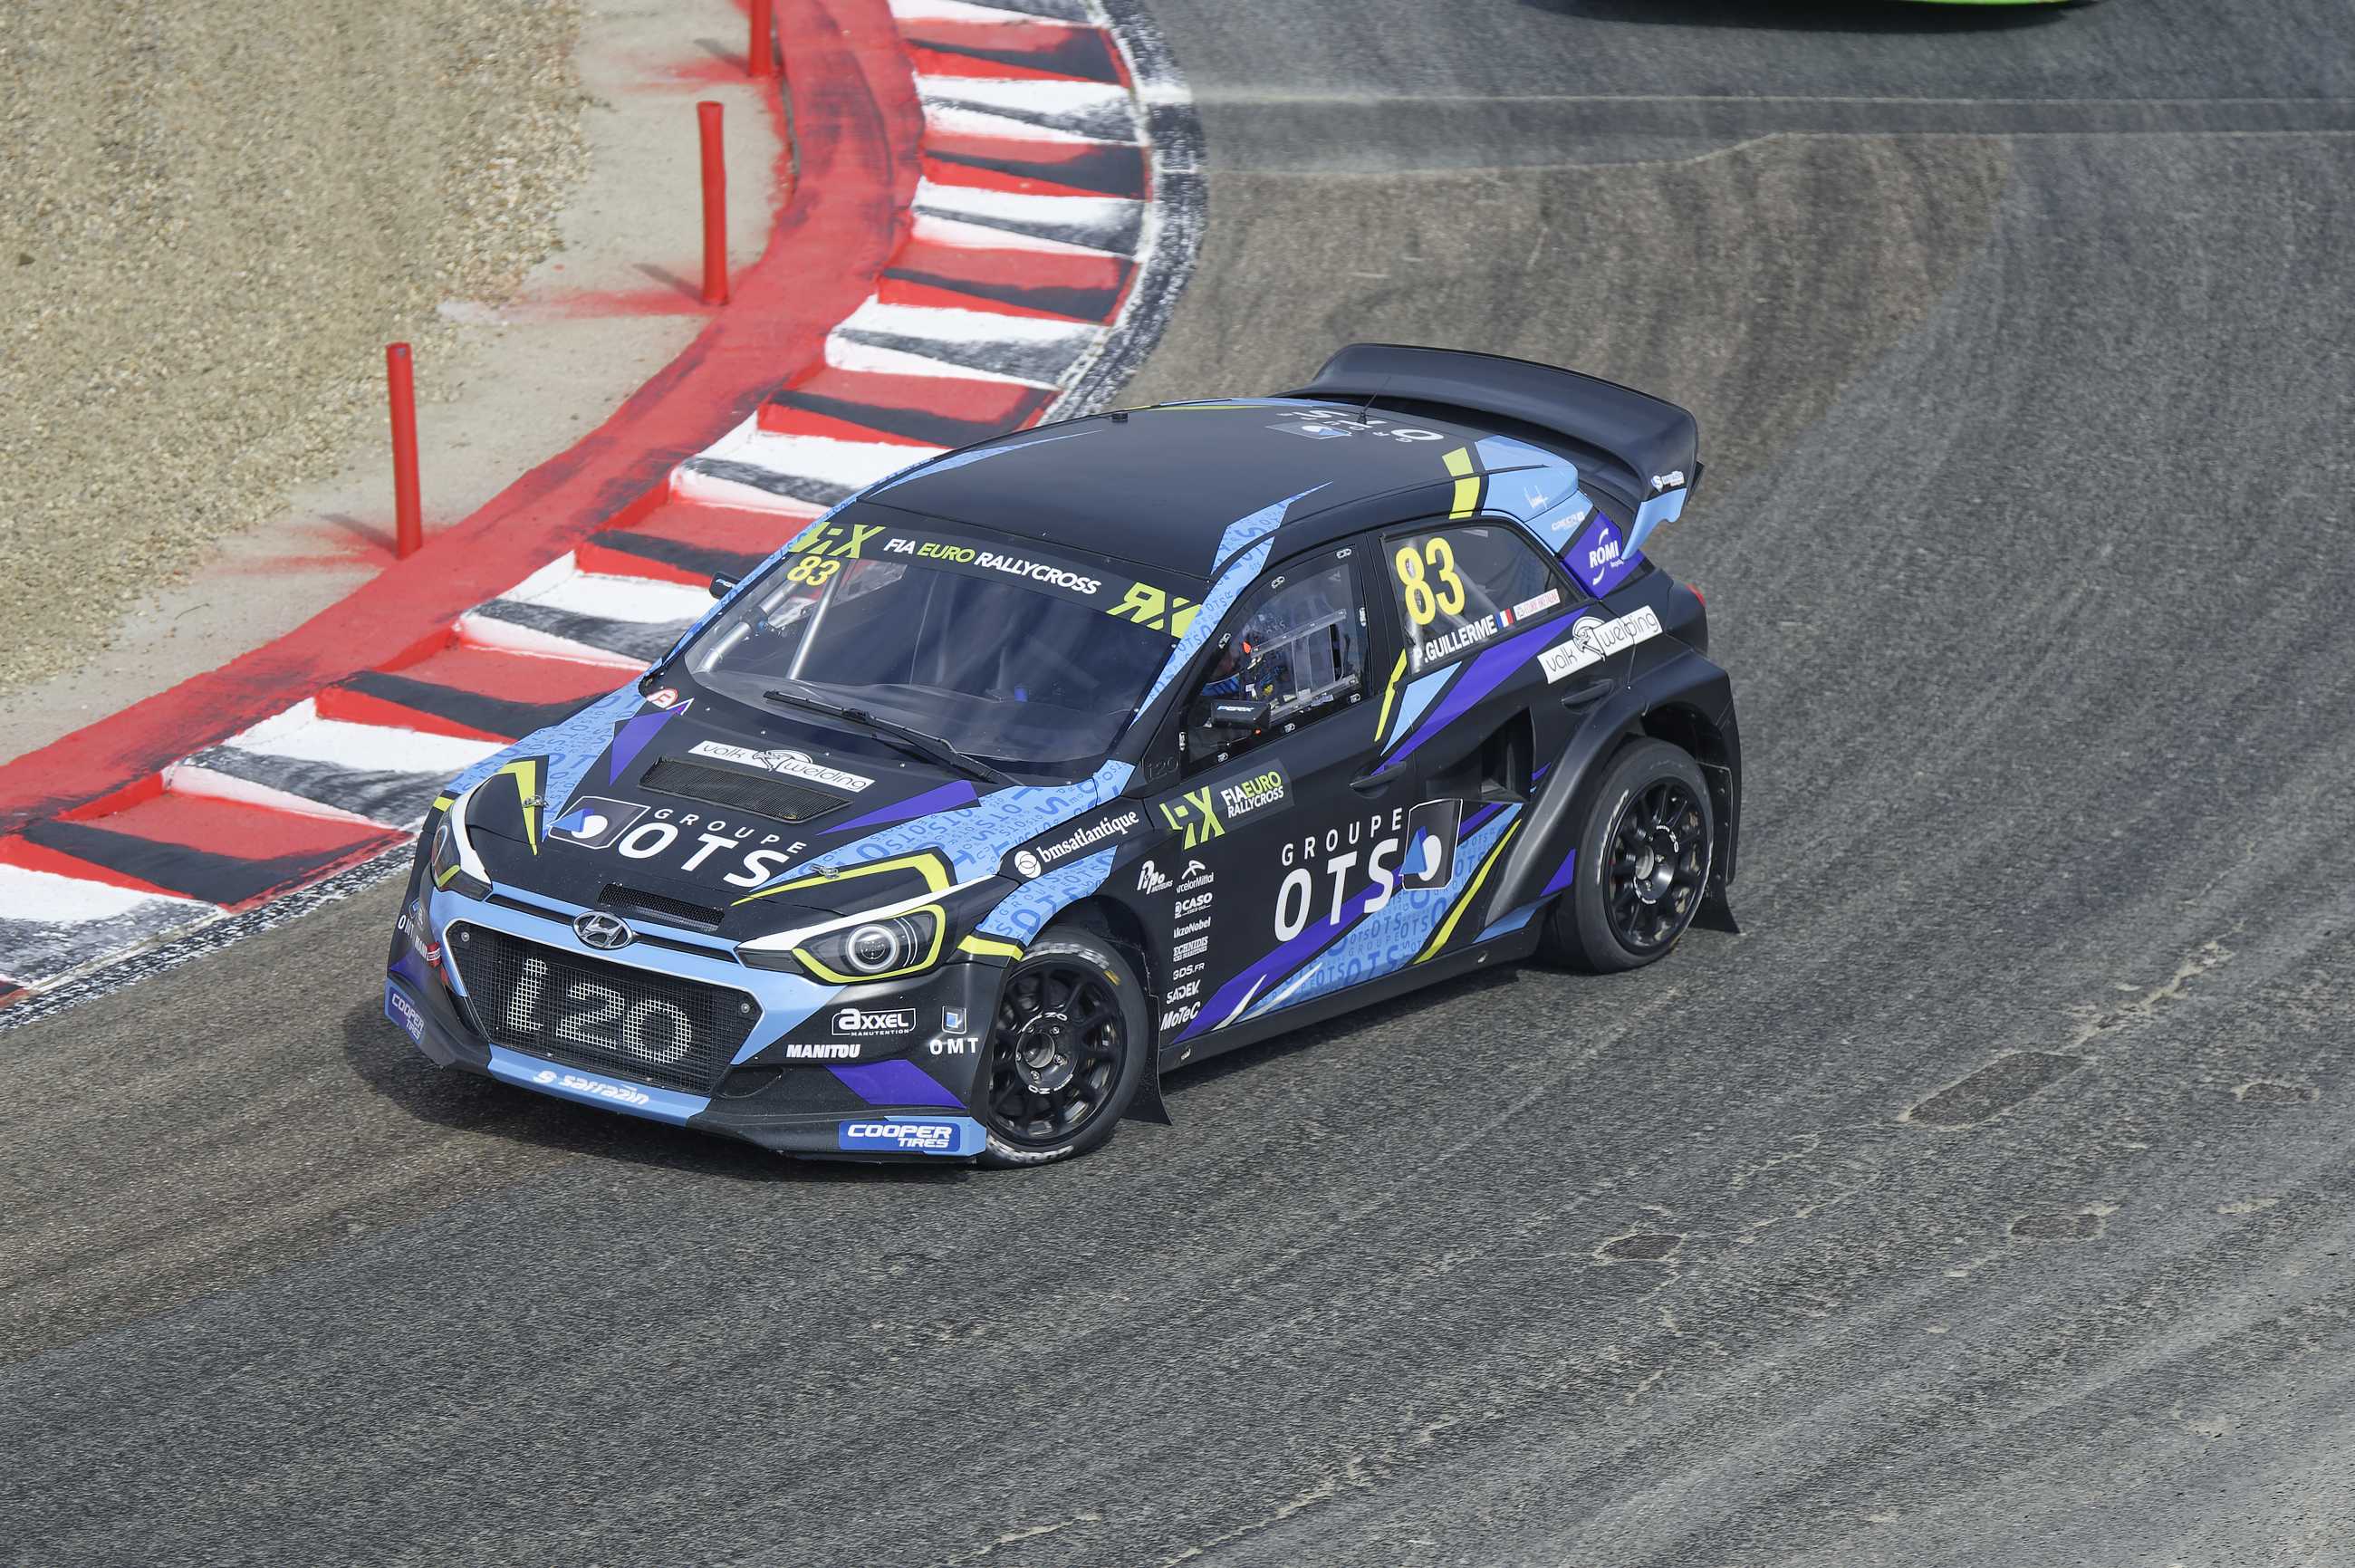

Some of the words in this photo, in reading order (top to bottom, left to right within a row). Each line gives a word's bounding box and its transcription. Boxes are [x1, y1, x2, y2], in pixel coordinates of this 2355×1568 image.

[786, 555, 841, 586] 83
[883, 538, 916, 554] FIA
[917, 543, 976, 563] EURO
[974, 552, 1101, 594] RALLYCROSS
[1589, 540, 1620, 569] ROMI
[1396, 537, 1465, 624] 83
[1545, 646, 1579, 672] valk
[1600, 612, 1659, 648] welding
[703, 745, 745, 759] valk
[783, 761, 867, 790] welding
[1226, 786, 1284, 818] RALLYCROSS
[654, 809, 806, 854] GROUPE
[1036, 810, 1139, 863] bmsatlantique
[1282, 807, 1403, 867] GROUPE
[618, 822, 790, 888] OTS
[1182, 892, 1213, 910] CASO
[1274, 838, 1399, 943] OTS
[391, 993, 424, 1029] COOPER
[1159, 1001, 1201, 1031] MoTeC
[785, 1044, 861, 1058] MANITOU
[929, 1037, 979, 1055] OMT
[558, 1075, 650, 1105] sarrazin
[847, 1124, 952, 1140] COOPER
[898, 1137, 949, 1148] TIRES
